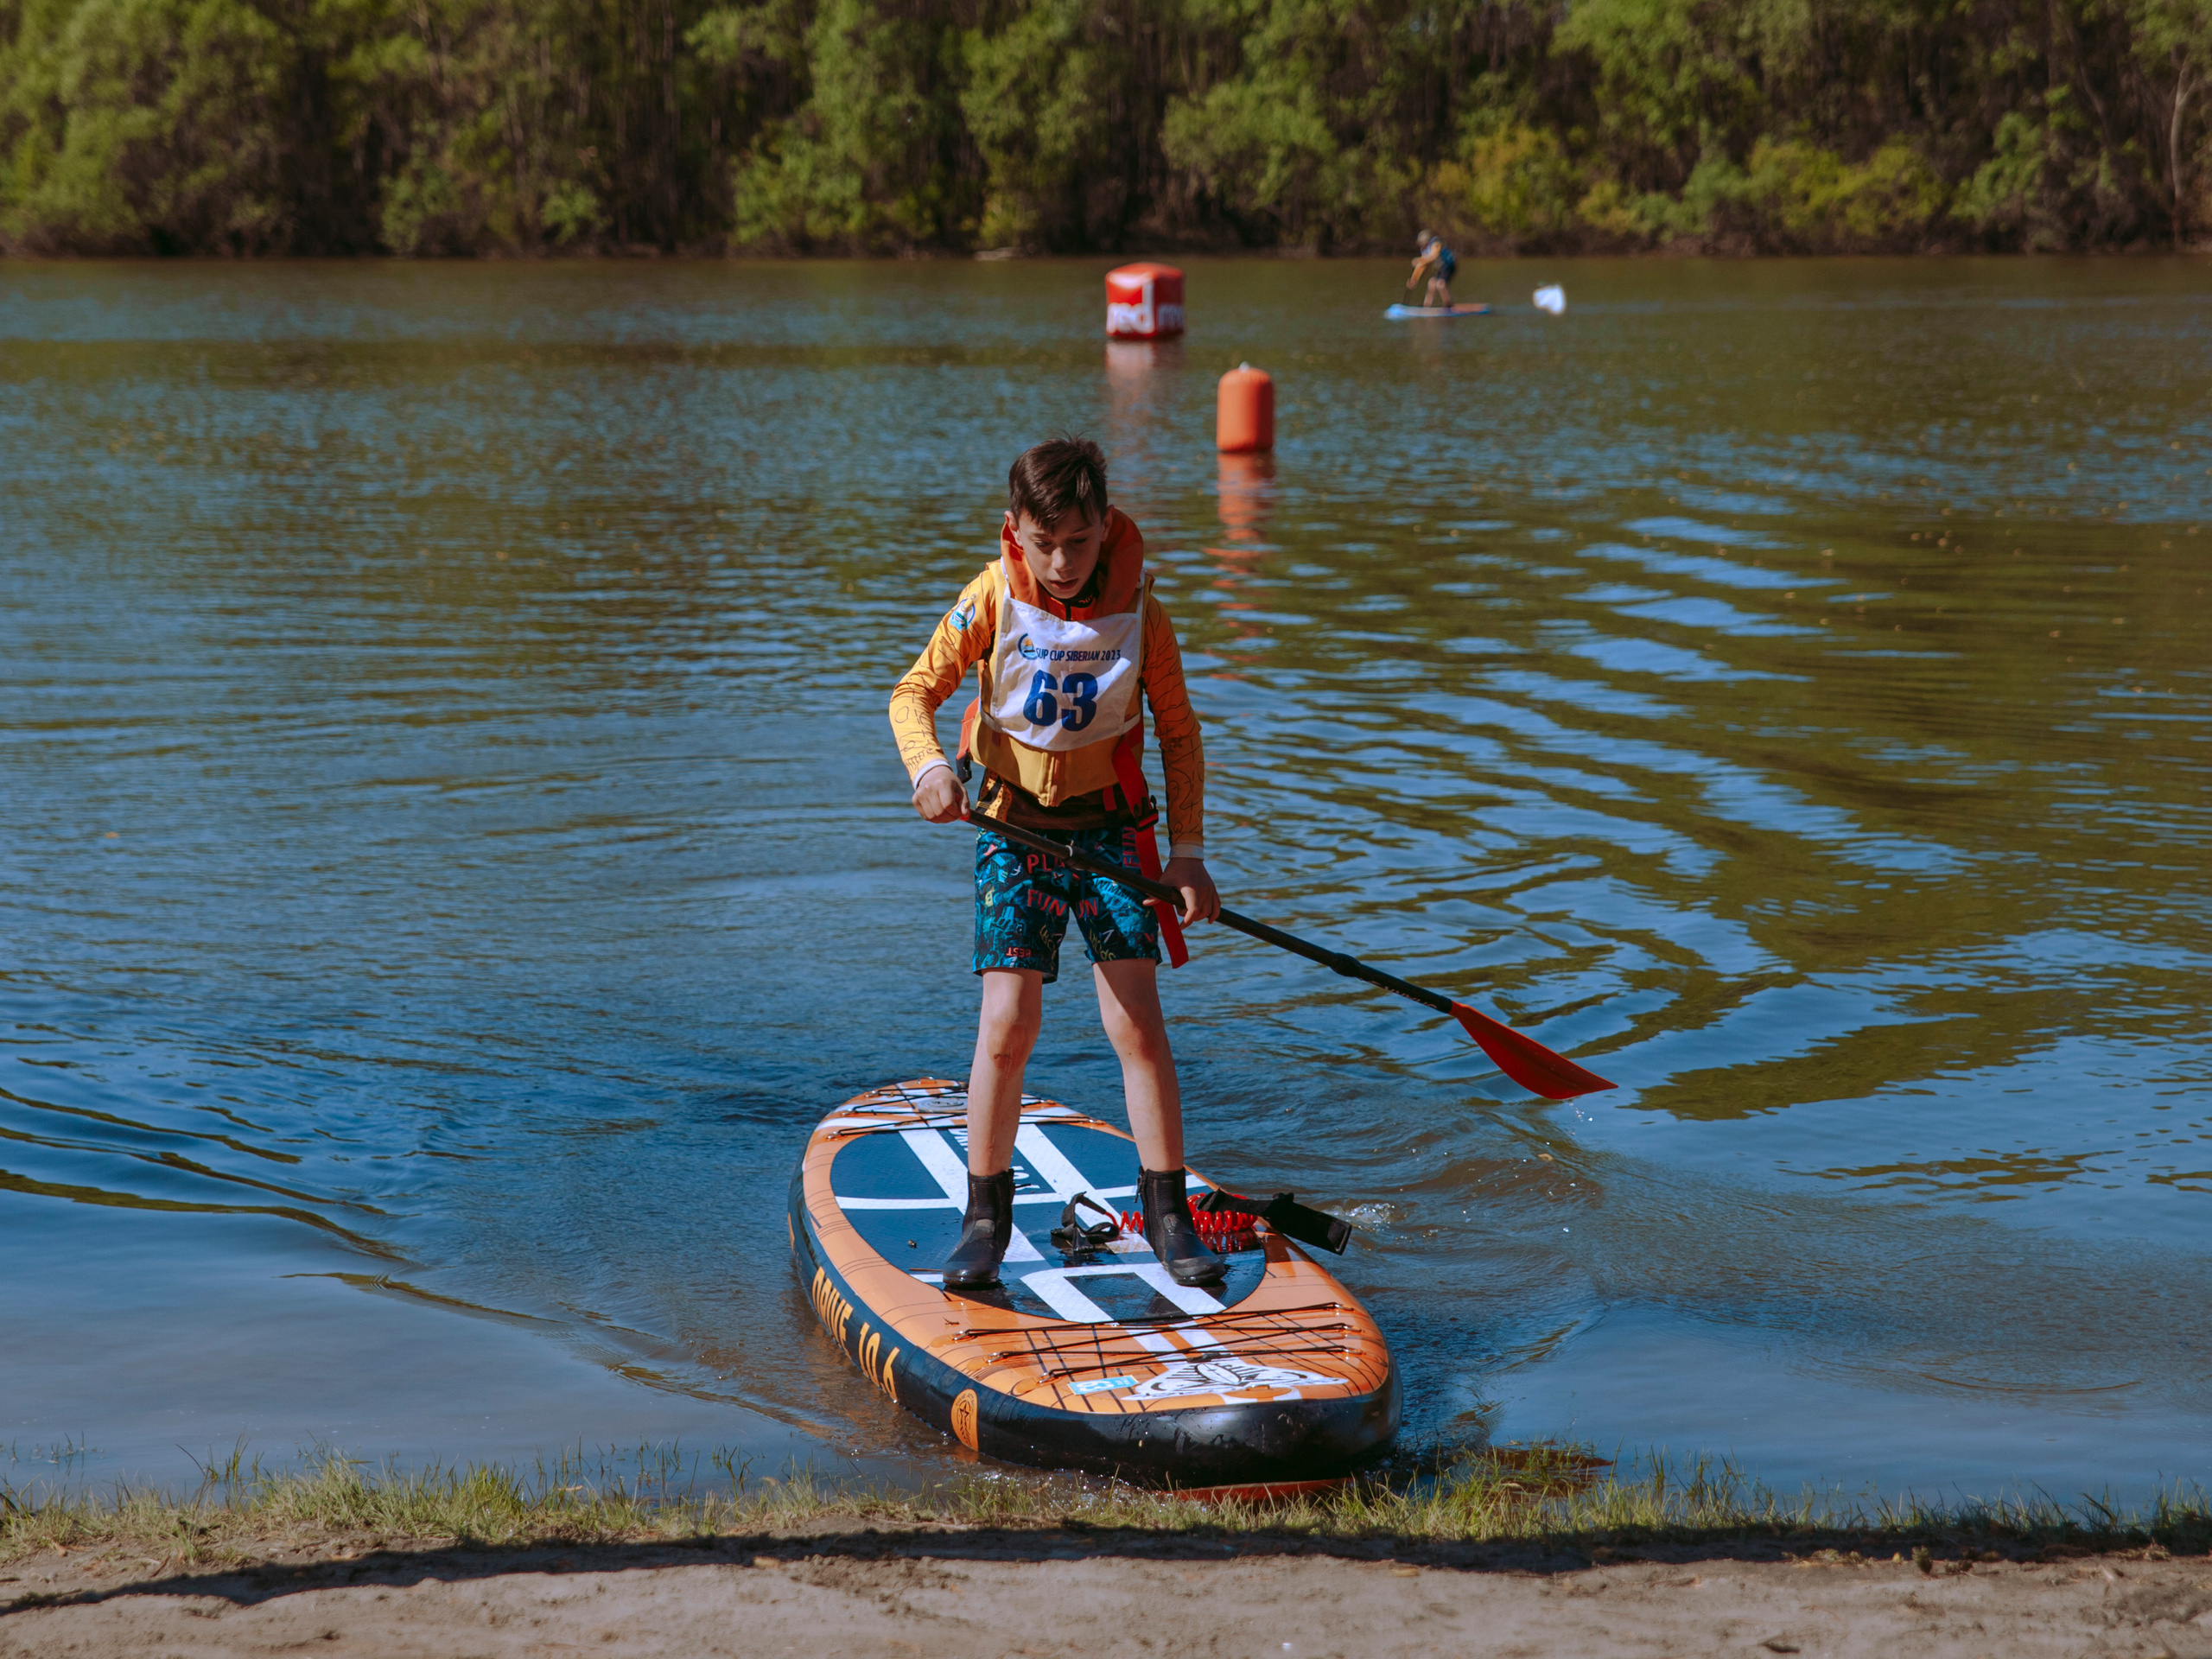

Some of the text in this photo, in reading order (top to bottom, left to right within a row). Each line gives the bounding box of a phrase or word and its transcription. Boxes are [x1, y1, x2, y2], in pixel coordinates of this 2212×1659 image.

[1107, 277, 1155, 334] red
[1036, 648, 1122, 662] SUP CUP SIBERIAN 2023
[1023, 670, 1098, 732] 63
[1027, 888, 1068, 917] FUN
